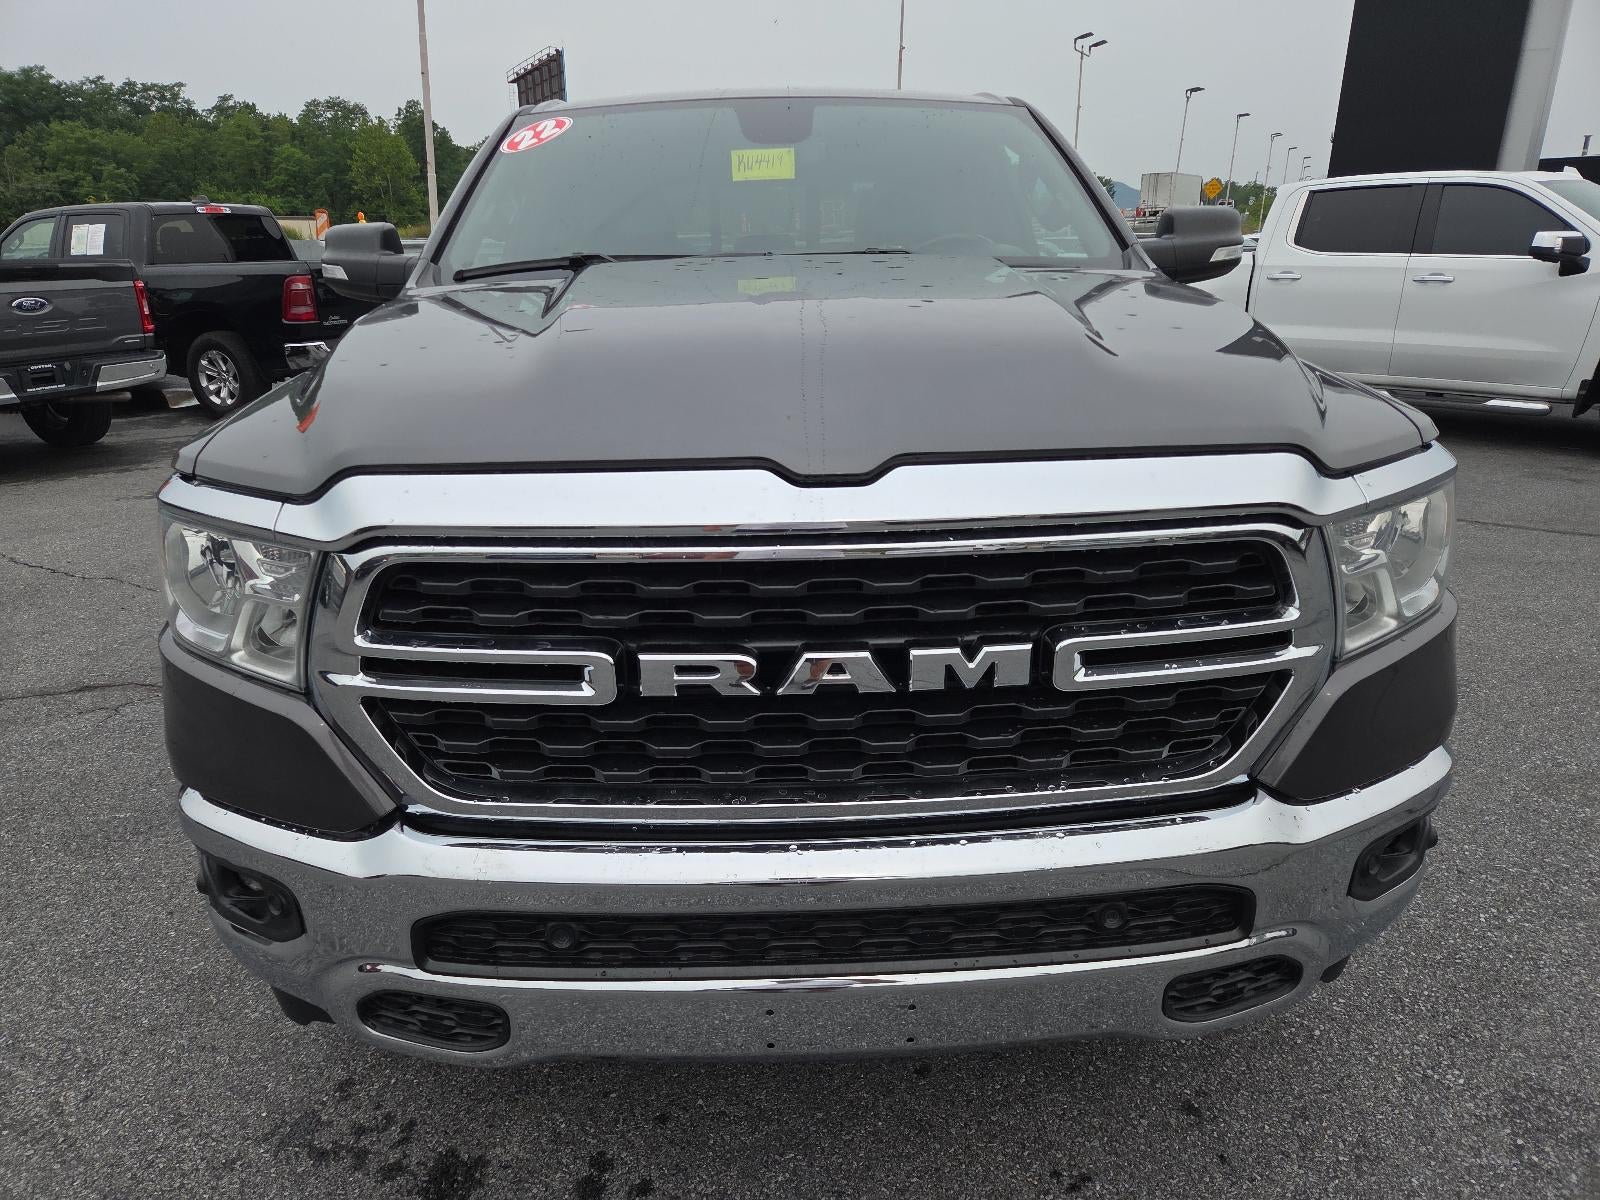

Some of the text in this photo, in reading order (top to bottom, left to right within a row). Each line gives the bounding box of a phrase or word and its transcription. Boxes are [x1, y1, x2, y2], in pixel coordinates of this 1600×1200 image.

[513, 119, 561, 150] 22
[21, 300, 42, 310] Ford
[638, 643, 1033, 697] RAM
